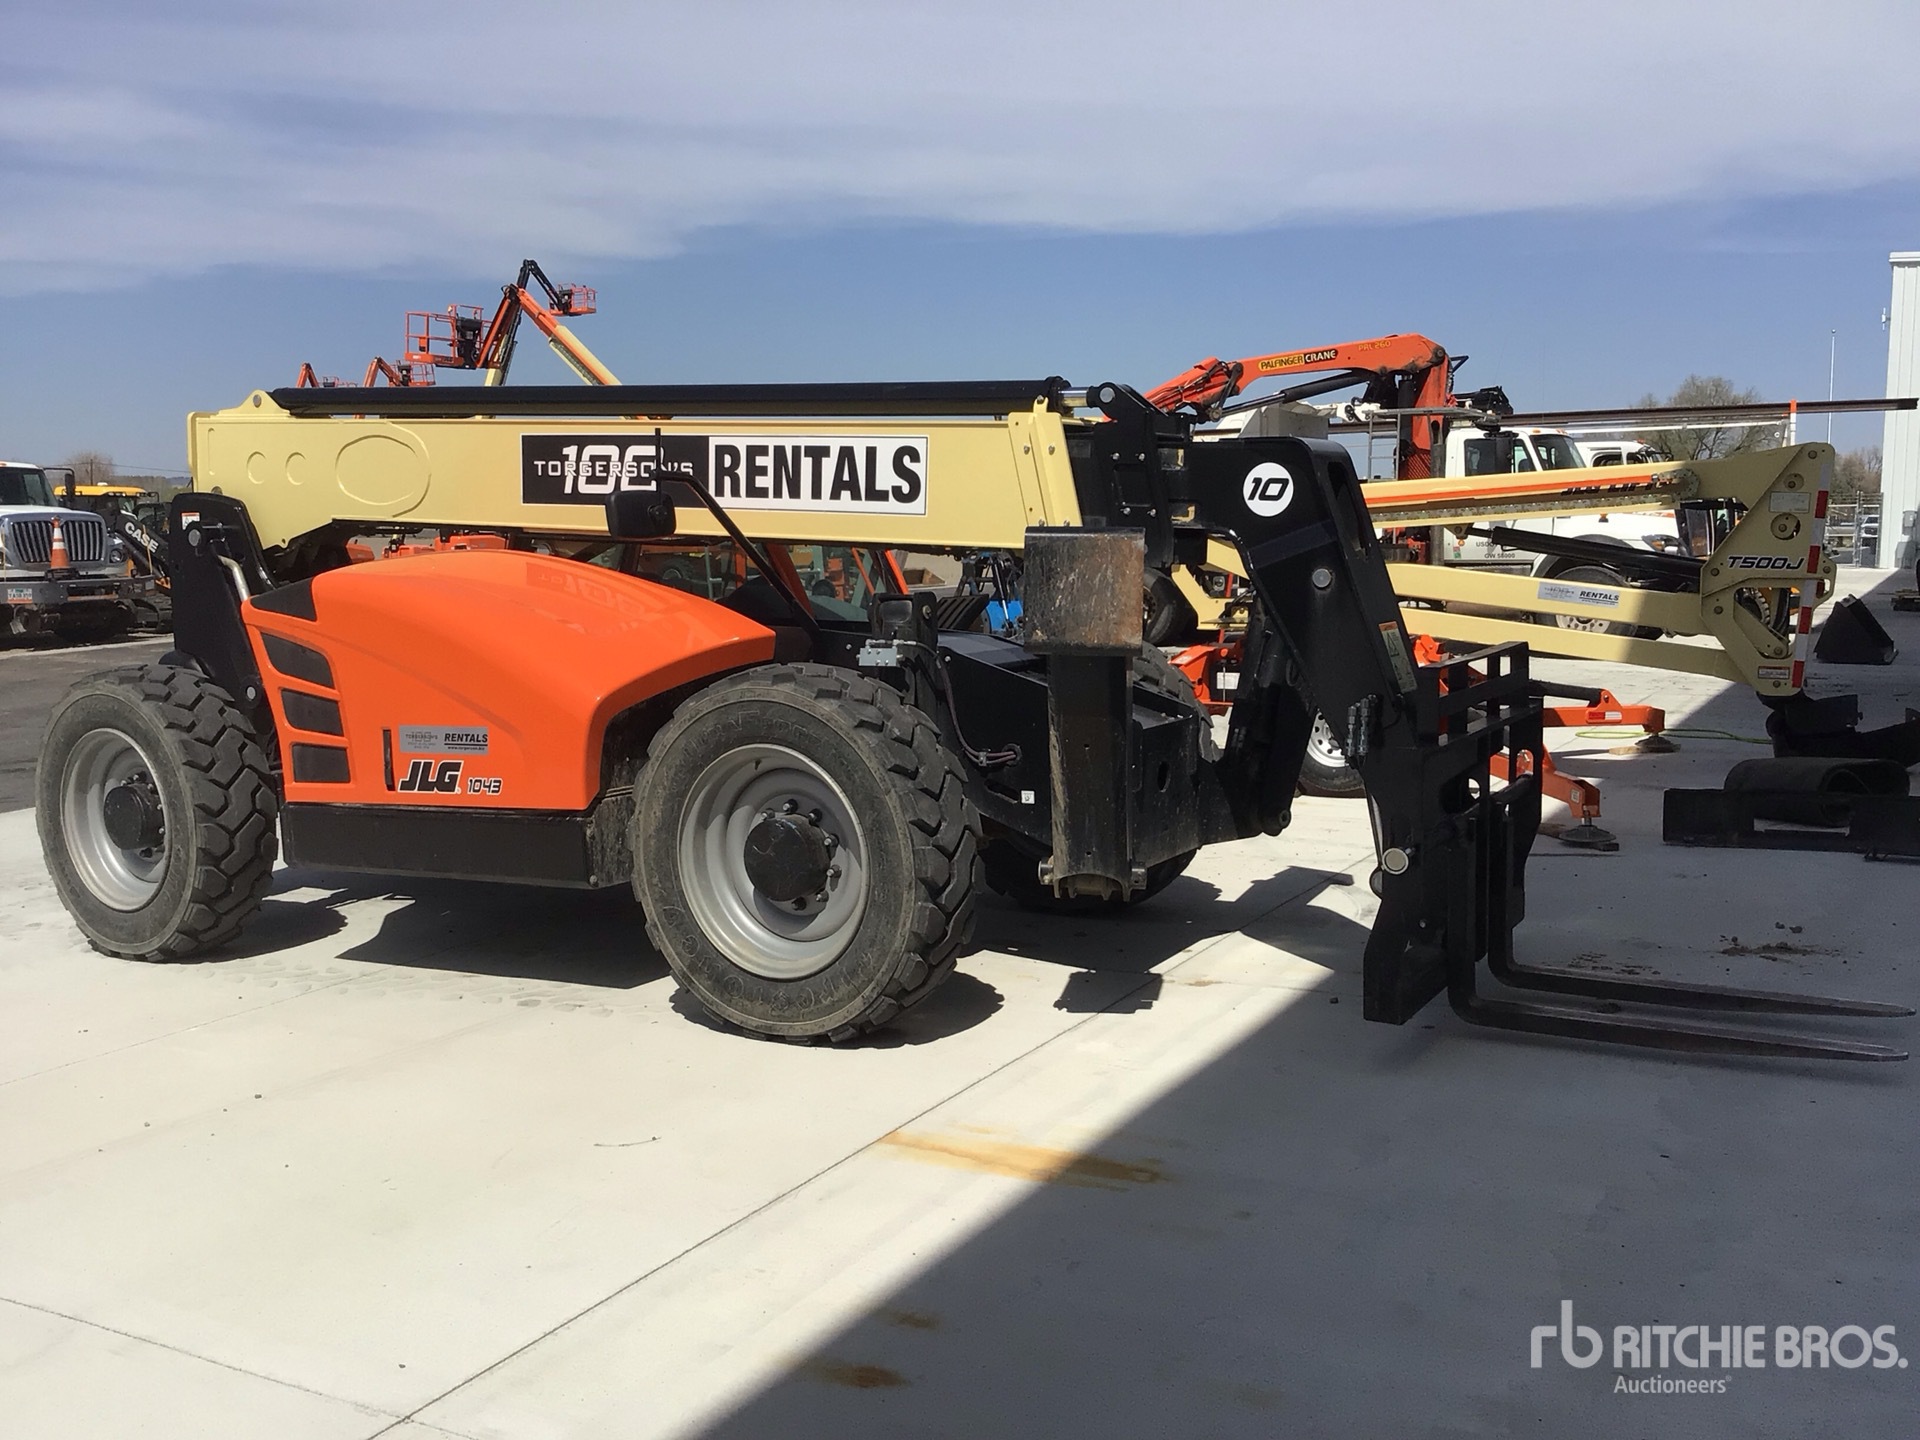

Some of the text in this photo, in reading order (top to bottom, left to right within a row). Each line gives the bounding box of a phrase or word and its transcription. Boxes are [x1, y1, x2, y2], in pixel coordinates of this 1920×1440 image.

[1260, 349, 1336, 370] PALFINGER CRANE
[714, 445, 921, 503] RENTALS
[1247, 478, 1289, 501] 10
[125, 522, 159, 553] CASE
[1728, 555, 1805, 570] T500J
[1580, 590, 1620, 601] RENTALS
[444, 733, 488, 743] RENTALS
[398, 759, 503, 795] JLG 1043
